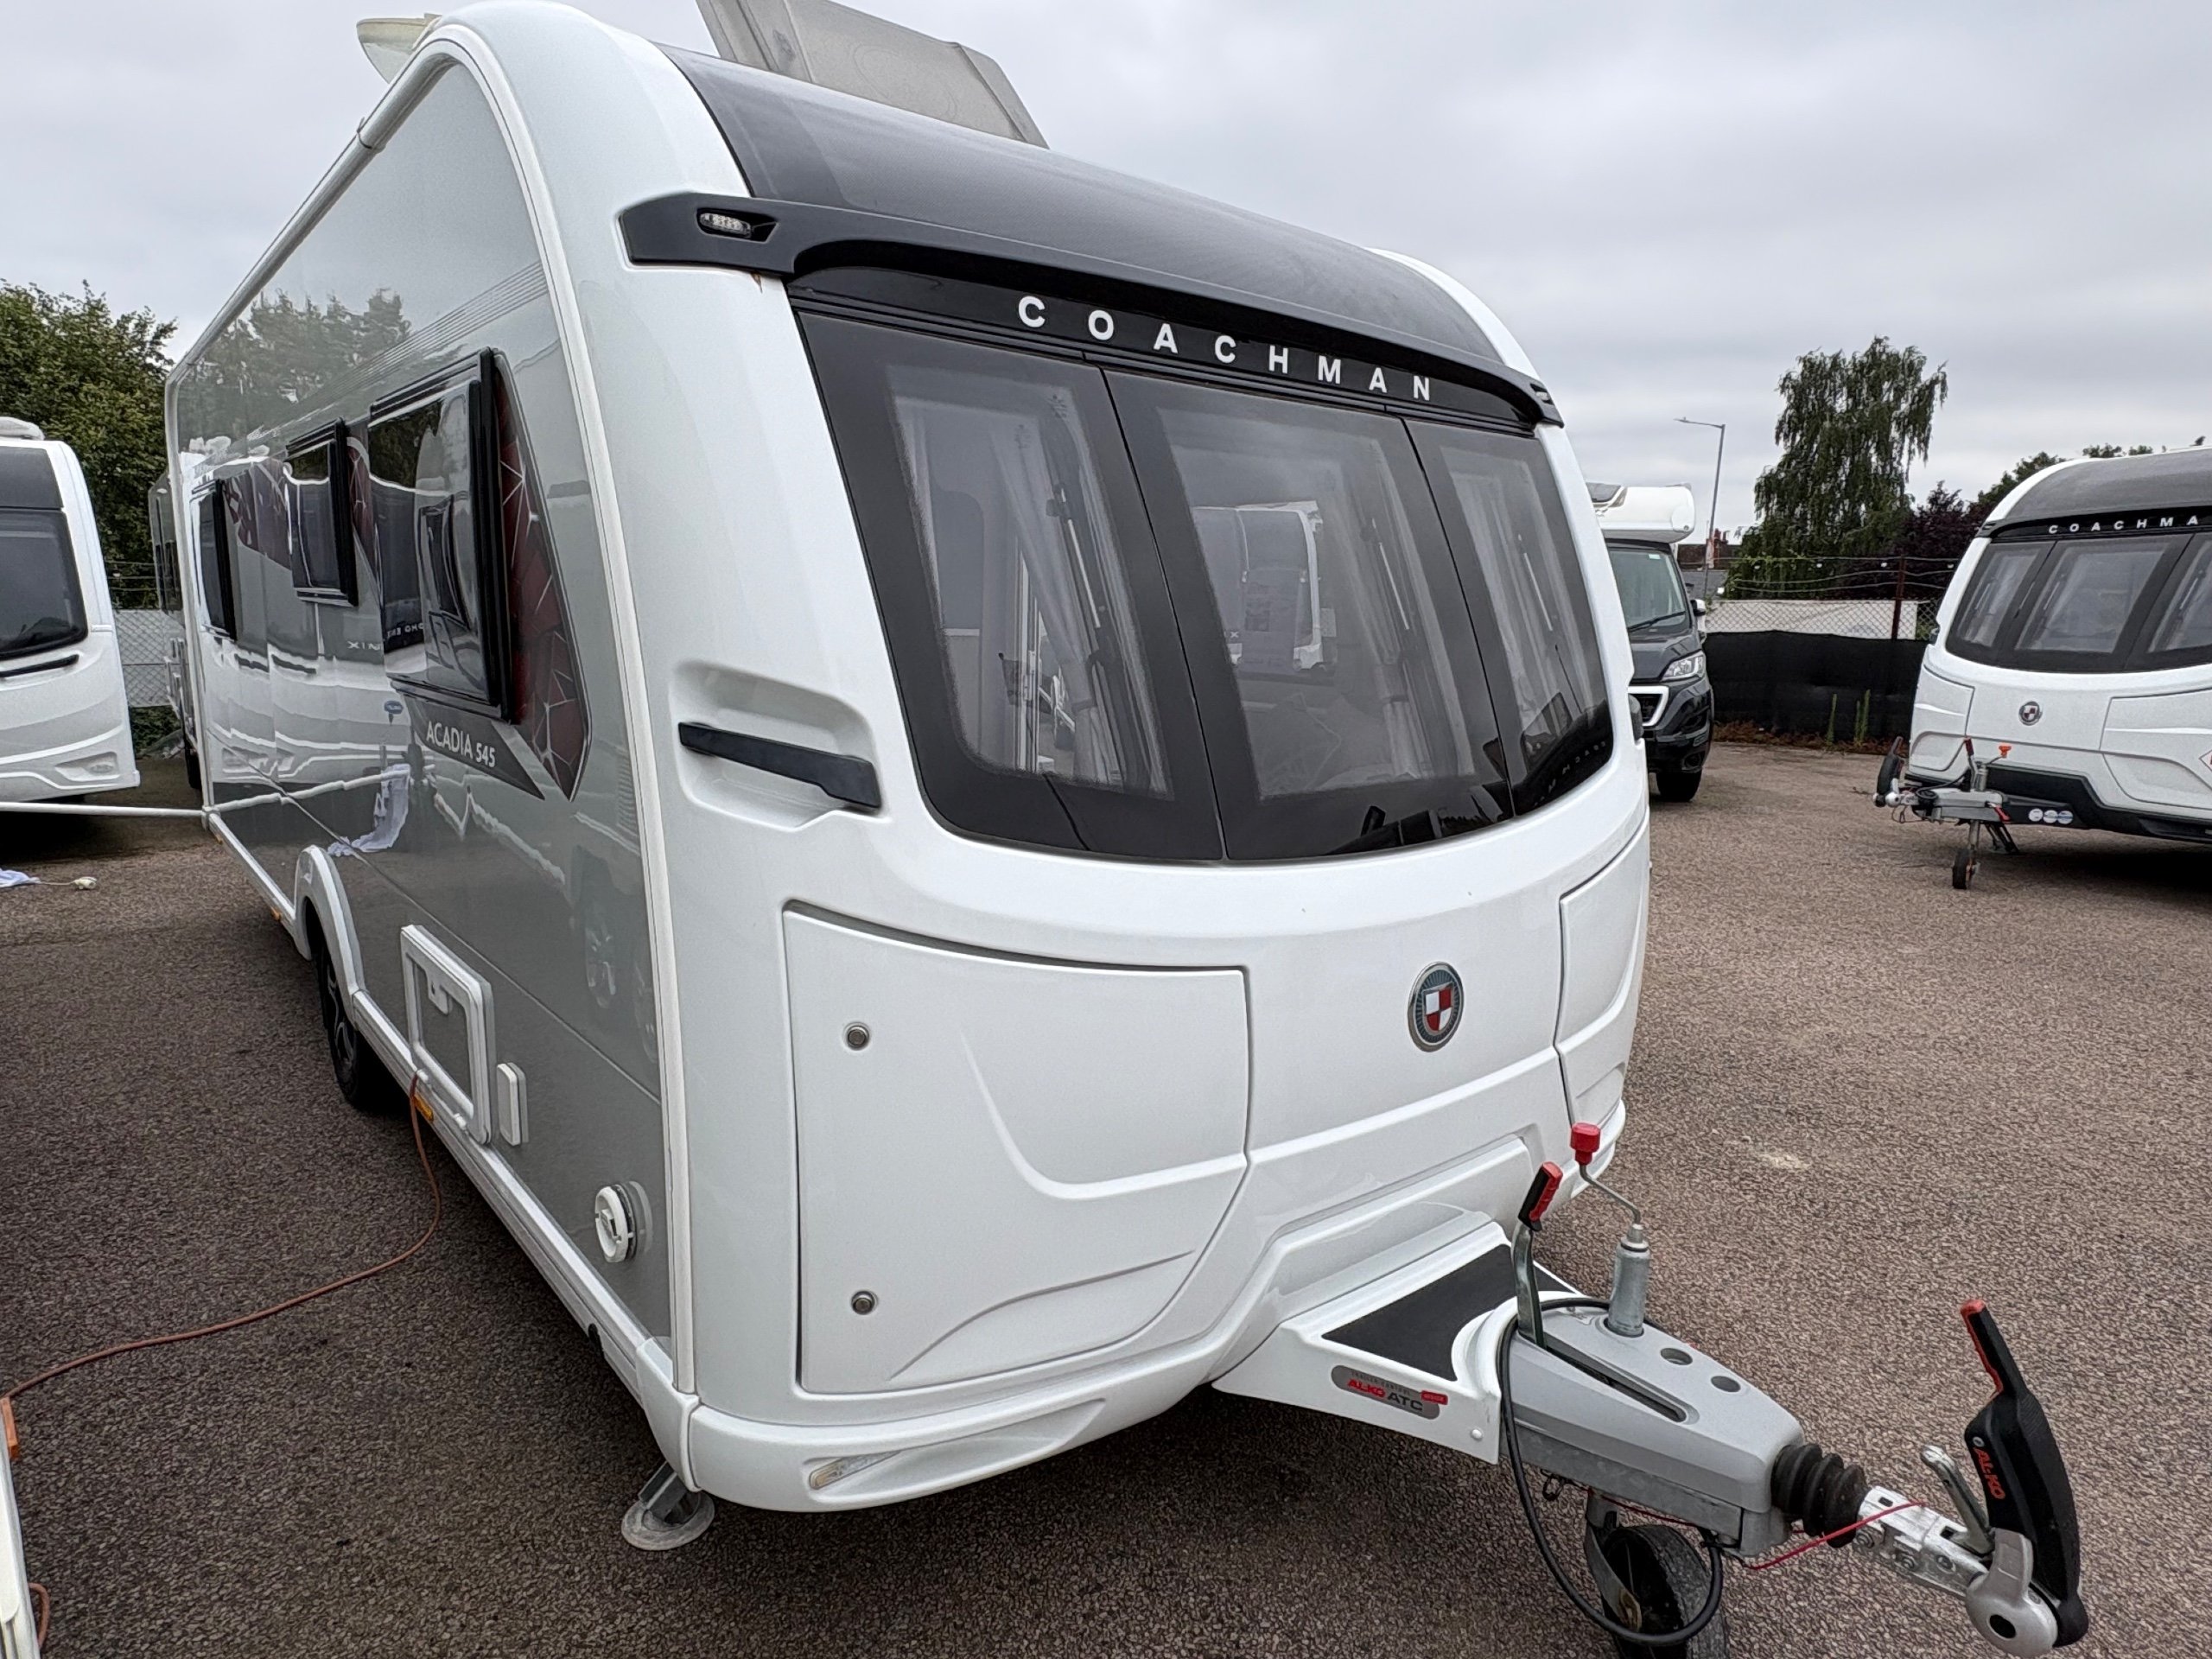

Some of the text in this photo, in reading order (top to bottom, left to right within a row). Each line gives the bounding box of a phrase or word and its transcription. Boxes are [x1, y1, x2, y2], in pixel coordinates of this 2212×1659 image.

[1018, 296, 1430, 401] COACHMAN
[426, 721, 495, 767] ACADIA 545
[1388, 1392, 1423, 1411] ATC
